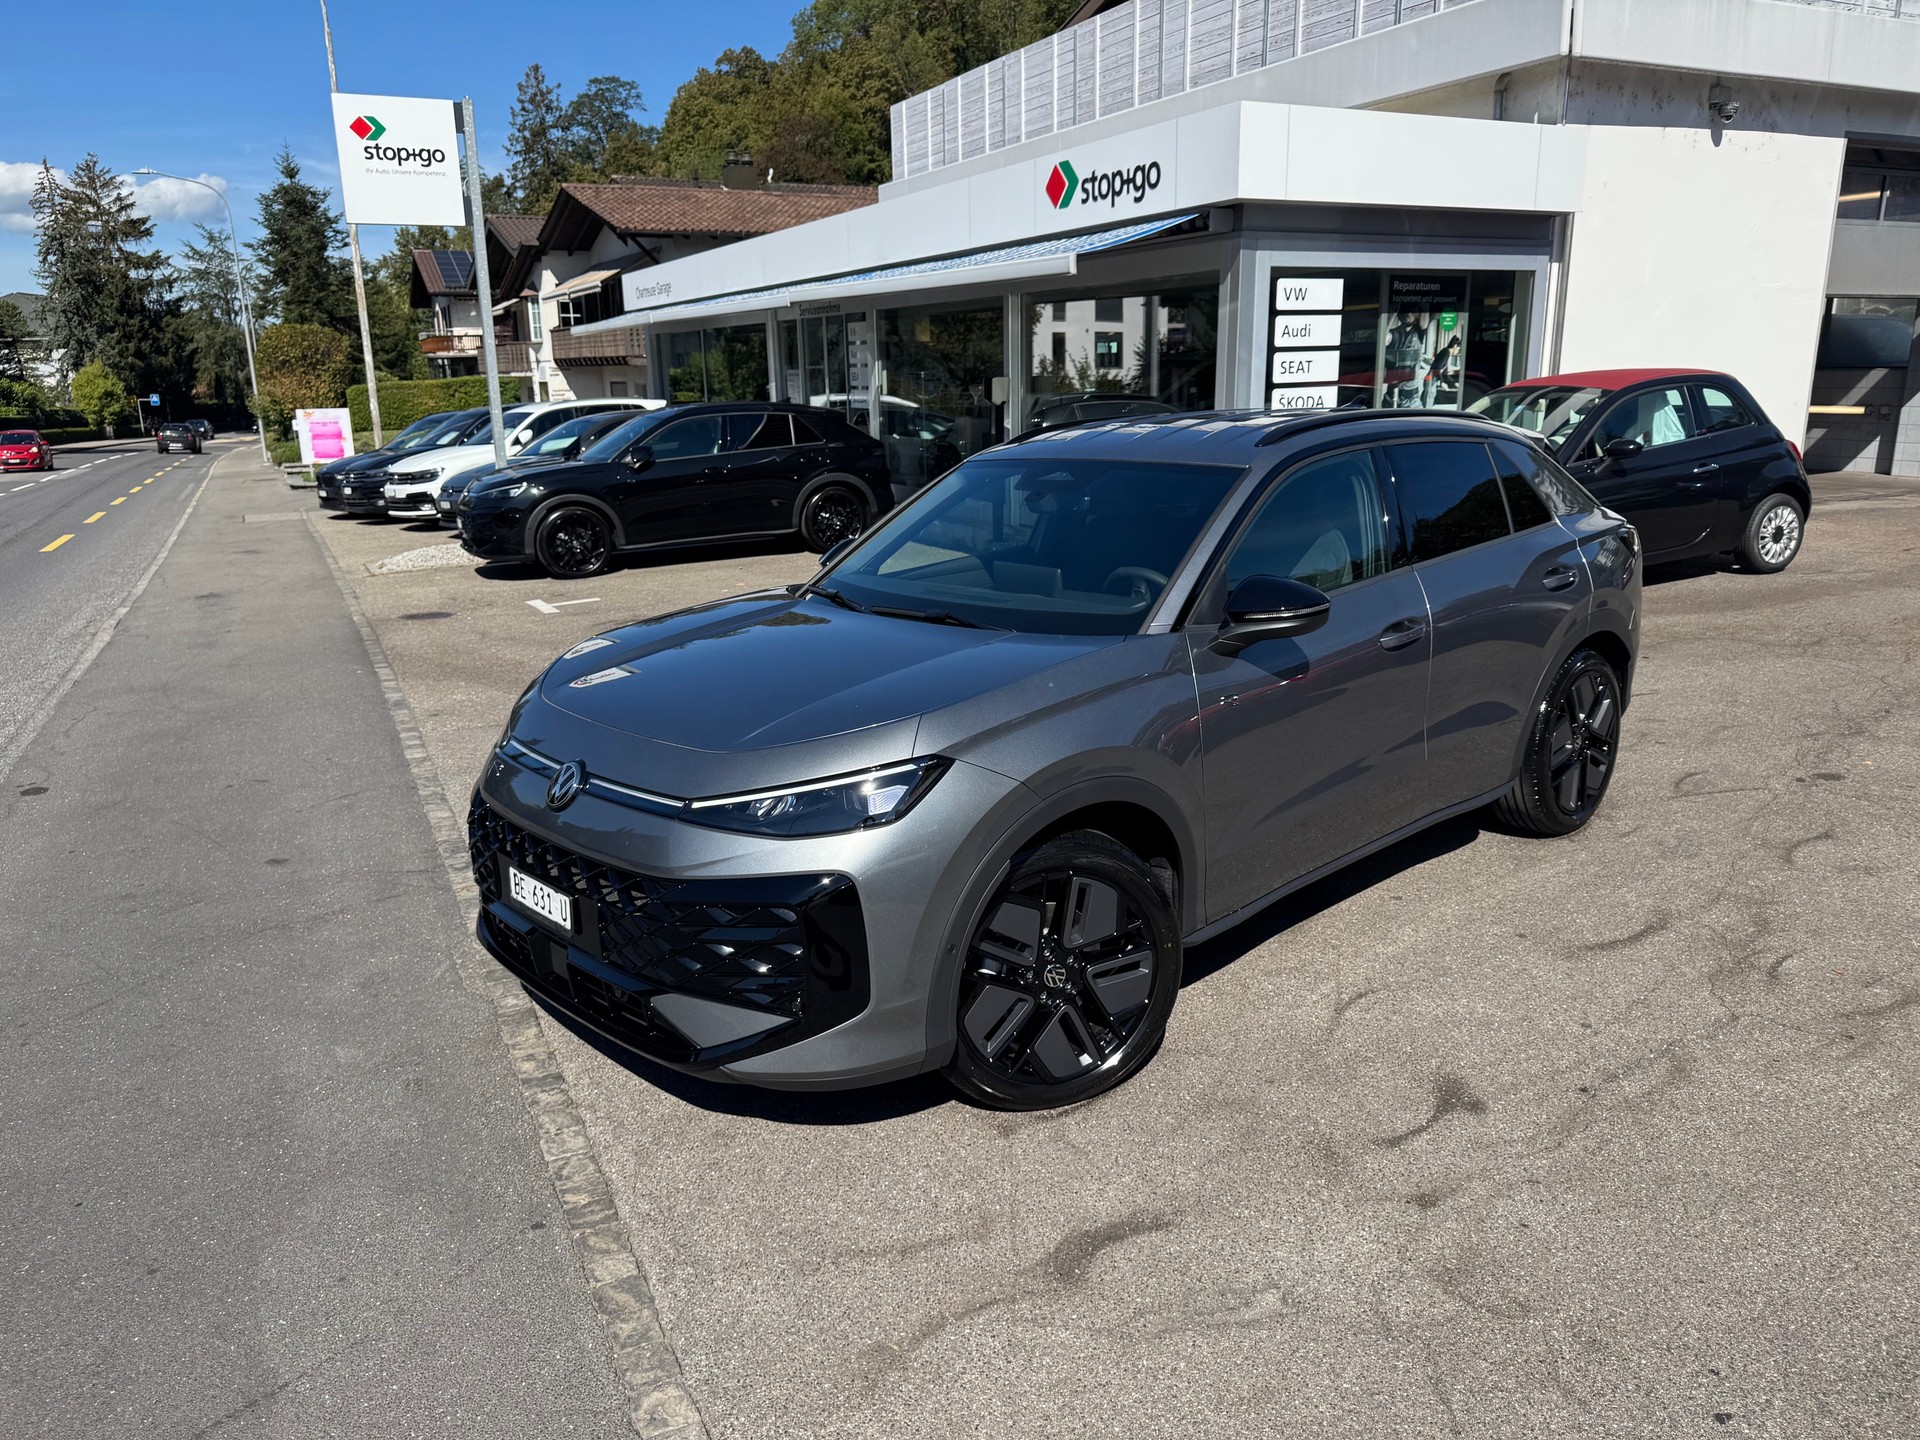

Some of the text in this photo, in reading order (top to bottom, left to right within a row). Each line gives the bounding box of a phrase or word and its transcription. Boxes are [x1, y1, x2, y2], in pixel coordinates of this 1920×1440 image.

[364, 143, 446, 168] stop+go
[1081, 161, 1161, 208] stop+go
[1393, 280, 1441, 292] Reparaturen
[1283, 287, 1308, 301] VW
[1281, 323, 1312, 338] Audi
[1279, 360, 1313, 375] SEAT
[532, 884, 553, 915] 631
[559, 900, 568, 923] U
